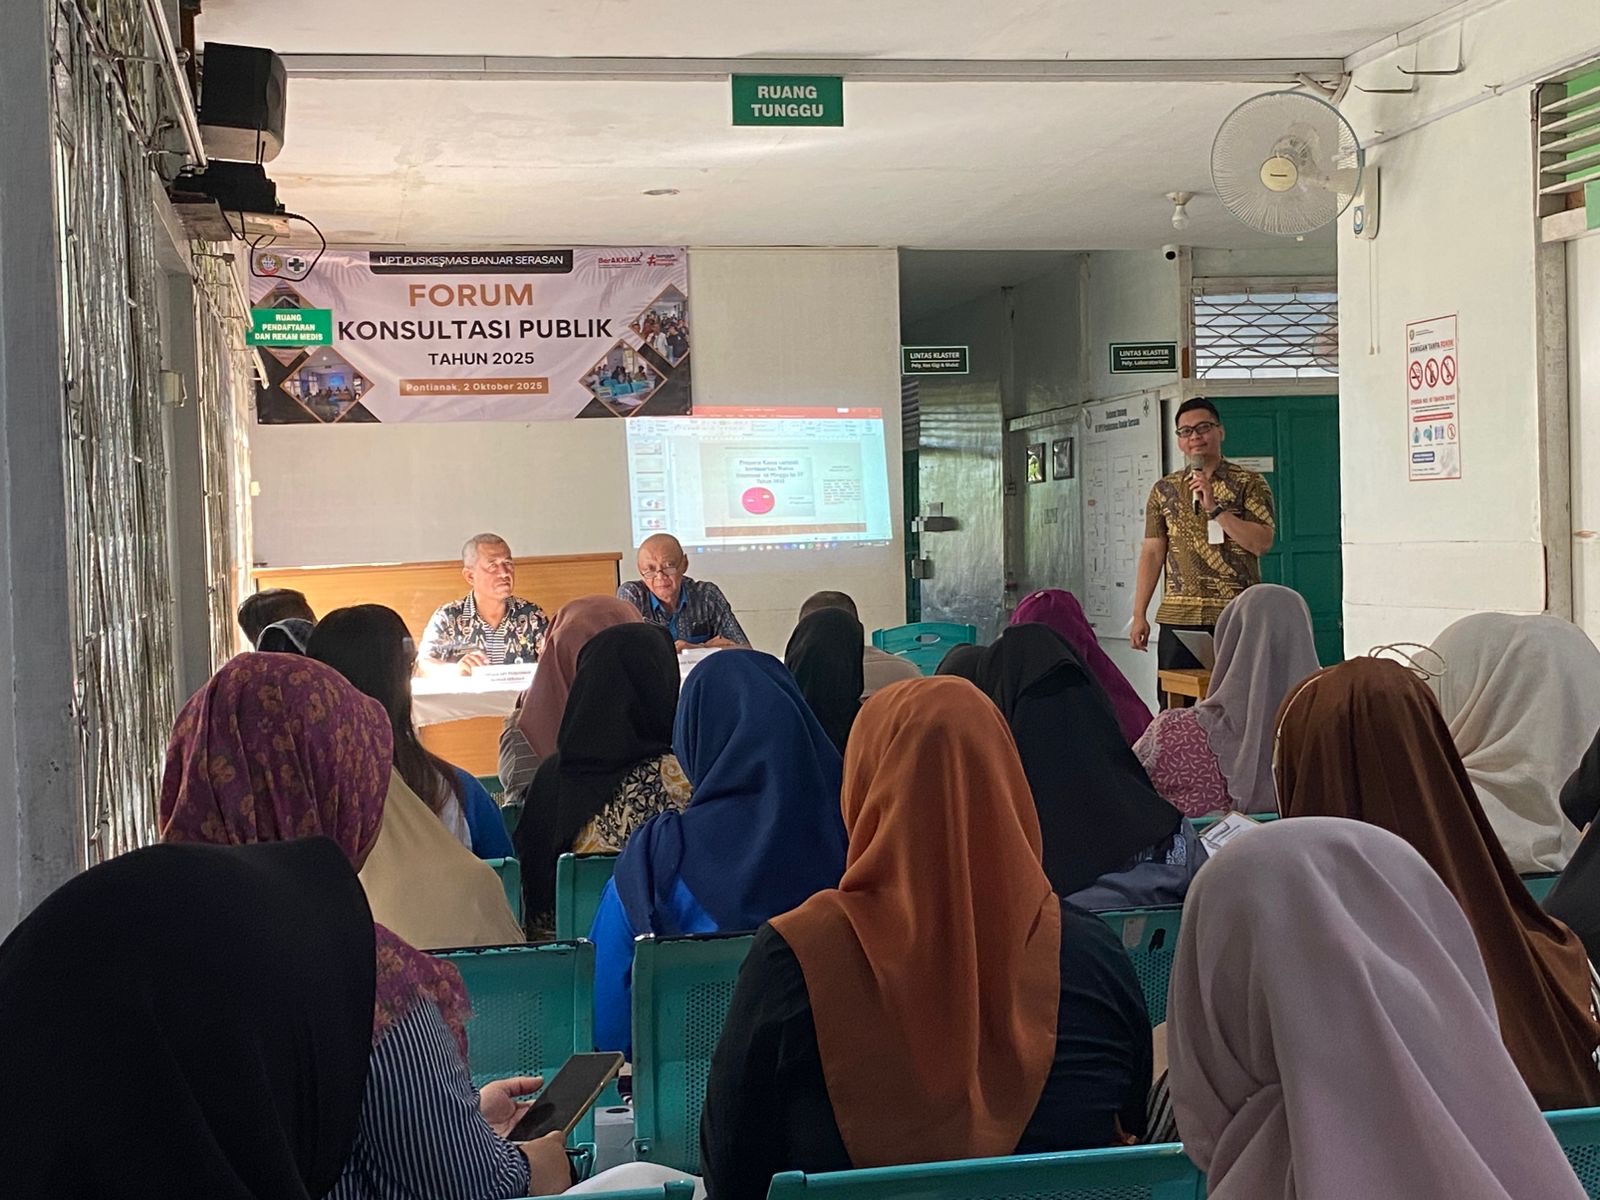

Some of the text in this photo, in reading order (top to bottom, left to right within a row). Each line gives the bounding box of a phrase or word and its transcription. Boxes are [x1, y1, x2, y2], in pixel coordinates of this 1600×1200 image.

[757, 85, 818, 99] RUANG
[751, 104, 824, 117] TUNGGU
[379, 255, 564, 266] UPT PUSKESMAS BANJAR SERASAN
[408, 283, 534, 307] FORUM
[275, 313, 302, 322] RUANG
[262, 323, 316, 331] PENDAFTARAN
[338, 318, 613, 341] KONSULTASI PUBLIK
[254, 333, 323, 341] DAN REKAM MEDIS
[427, 352, 535, 366] TAHUN 2025
[933, 351, 960, 359] KLASTER
[406, 381, 543, 393] Pontianak, 2 Oktober 2025
